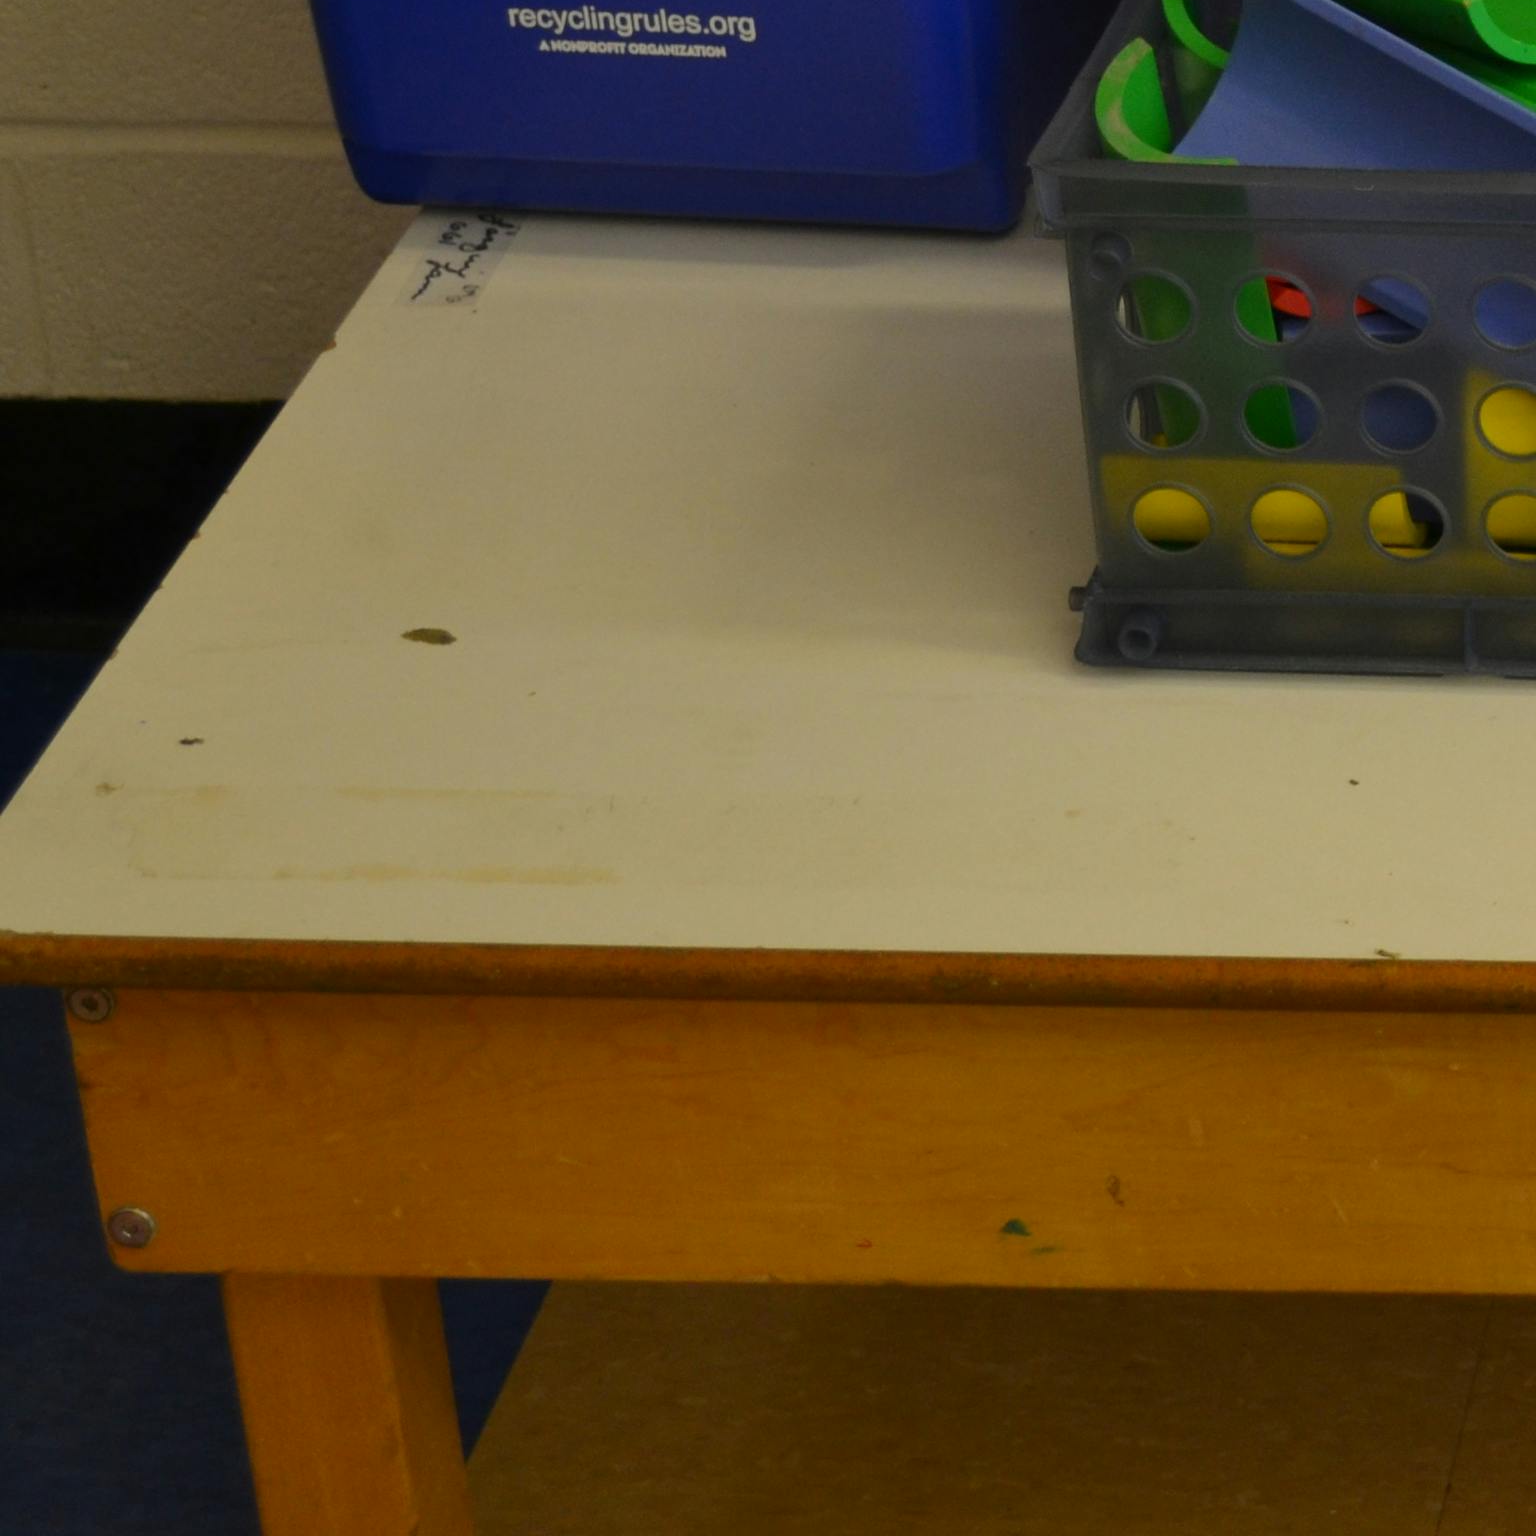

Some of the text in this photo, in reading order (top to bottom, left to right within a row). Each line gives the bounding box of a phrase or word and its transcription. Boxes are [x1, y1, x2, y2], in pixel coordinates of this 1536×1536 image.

[508, 6, 756, 41] recyclingrules.org
[539, 40, 727, 57] A NONPROFIT ORGANIZATION
